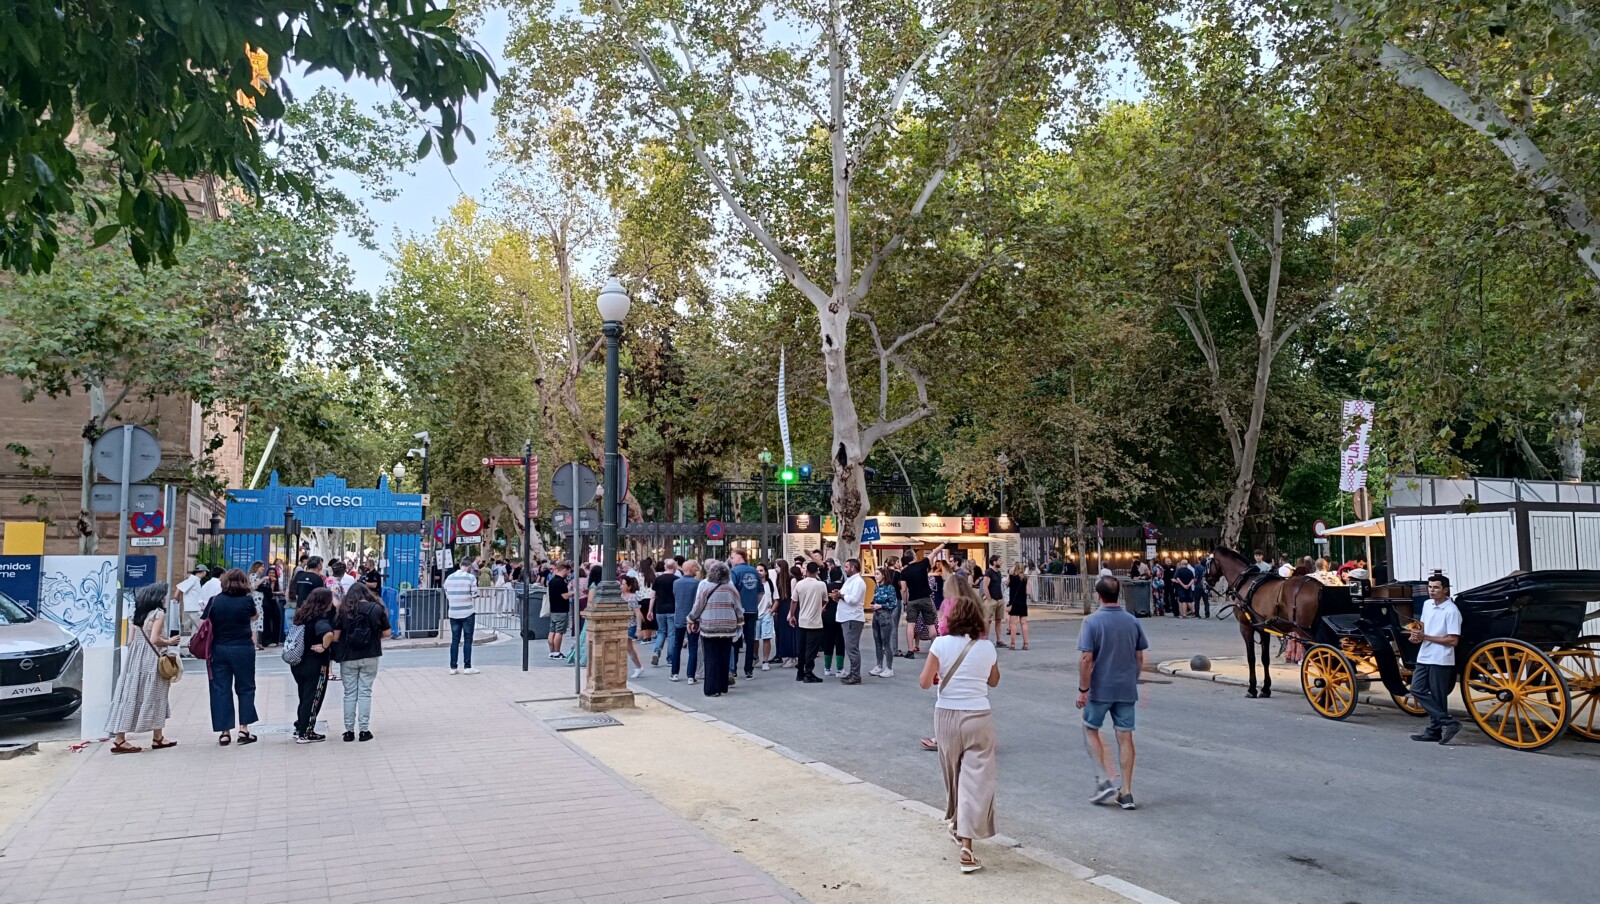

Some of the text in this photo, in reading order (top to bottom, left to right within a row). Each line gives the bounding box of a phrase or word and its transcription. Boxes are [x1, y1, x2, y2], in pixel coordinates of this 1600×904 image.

[296, 493, 362, 506] endesa
[864, 526, 878, 535] AXI
[12, 686, 41, 695] ARIYA
